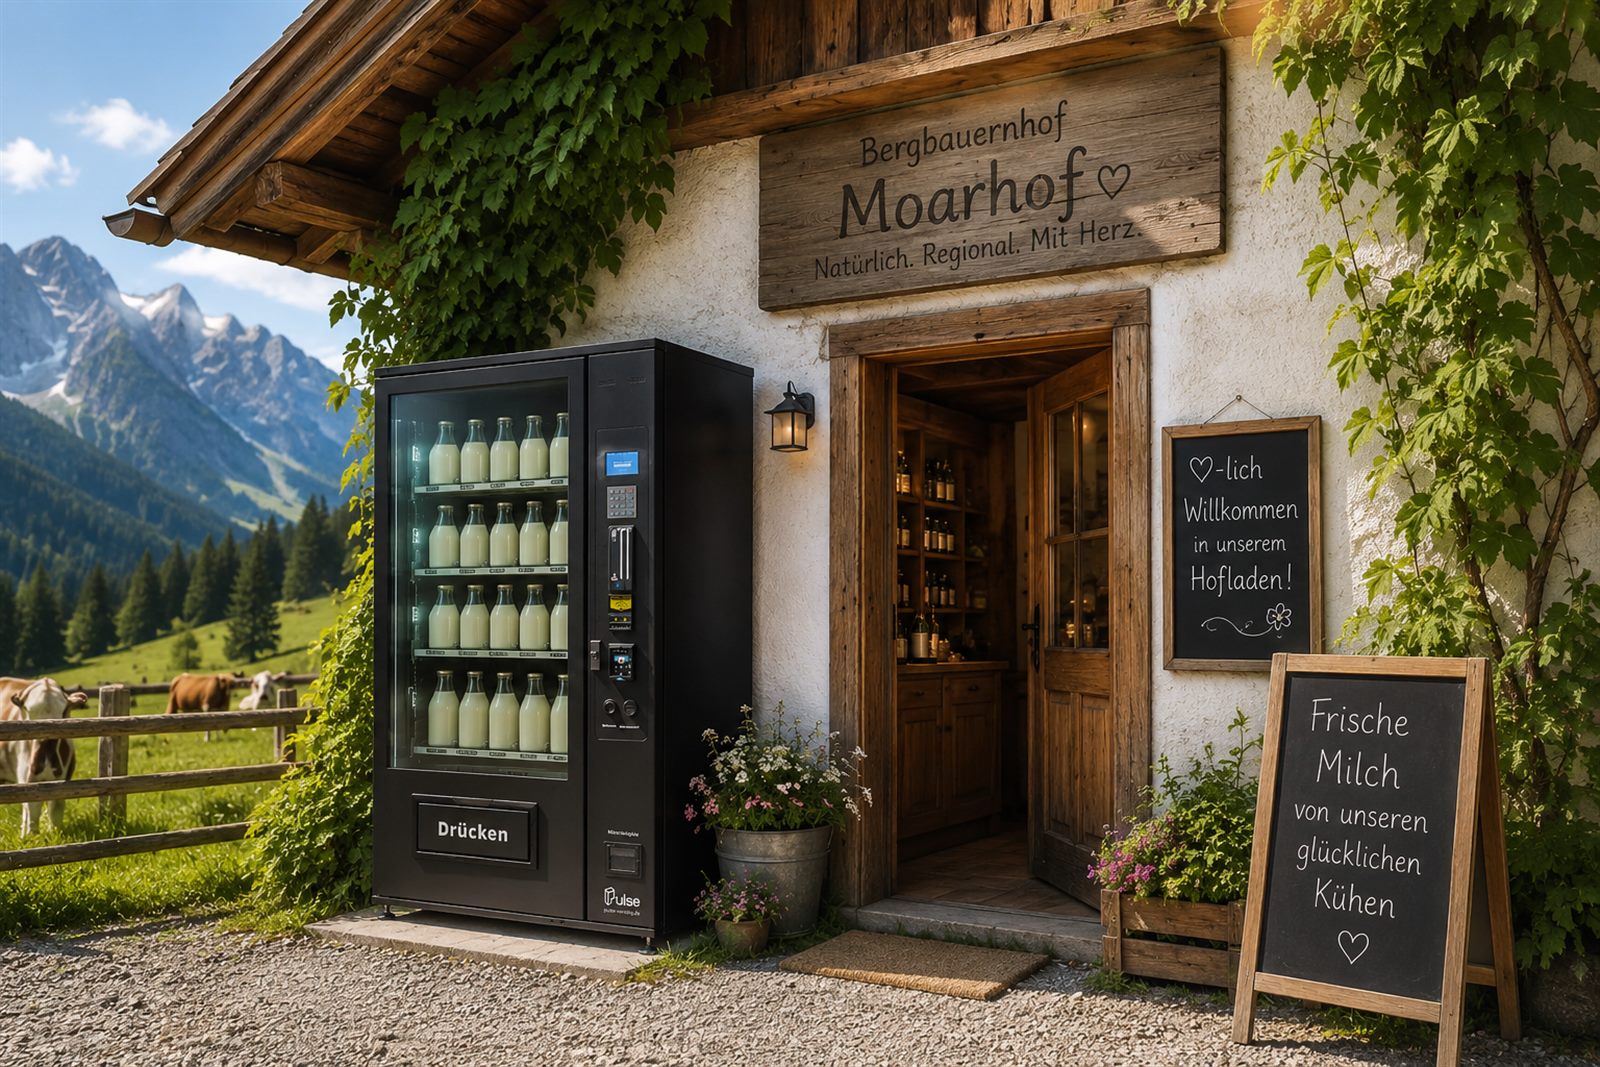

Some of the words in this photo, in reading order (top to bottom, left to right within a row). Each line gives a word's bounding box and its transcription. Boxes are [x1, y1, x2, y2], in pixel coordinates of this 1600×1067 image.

[859, 100, 1068, 167] Bergbauernhof
[839, 146, 1087, 240] Moarhof
[815, 247, 913, 280] Natürlich.
[922, 234, 1020, 270] Regional.
[1031, 226, 1069, 252] Mit
[1080, 219, 1142, 246] Herz.
[1184, 496, 1299, 523] Willkommen
[1194, 535, 1209, 553] in
[1216, 538, 1287, 553] unserem
[1191, 563, 1292, 598] Hofladen!
[1311, 697, 1409, 737] Frische
[1316, 748, 1400, 790] Milch
[438, 821, 508, 842] Drücken
[1294, 803, 1329, 823] von
[1340, 808, 1428, 834] unseren
[1296, 835, 1421, 876] glücklichen
[1314, 877, 1395, 919] Kühen
